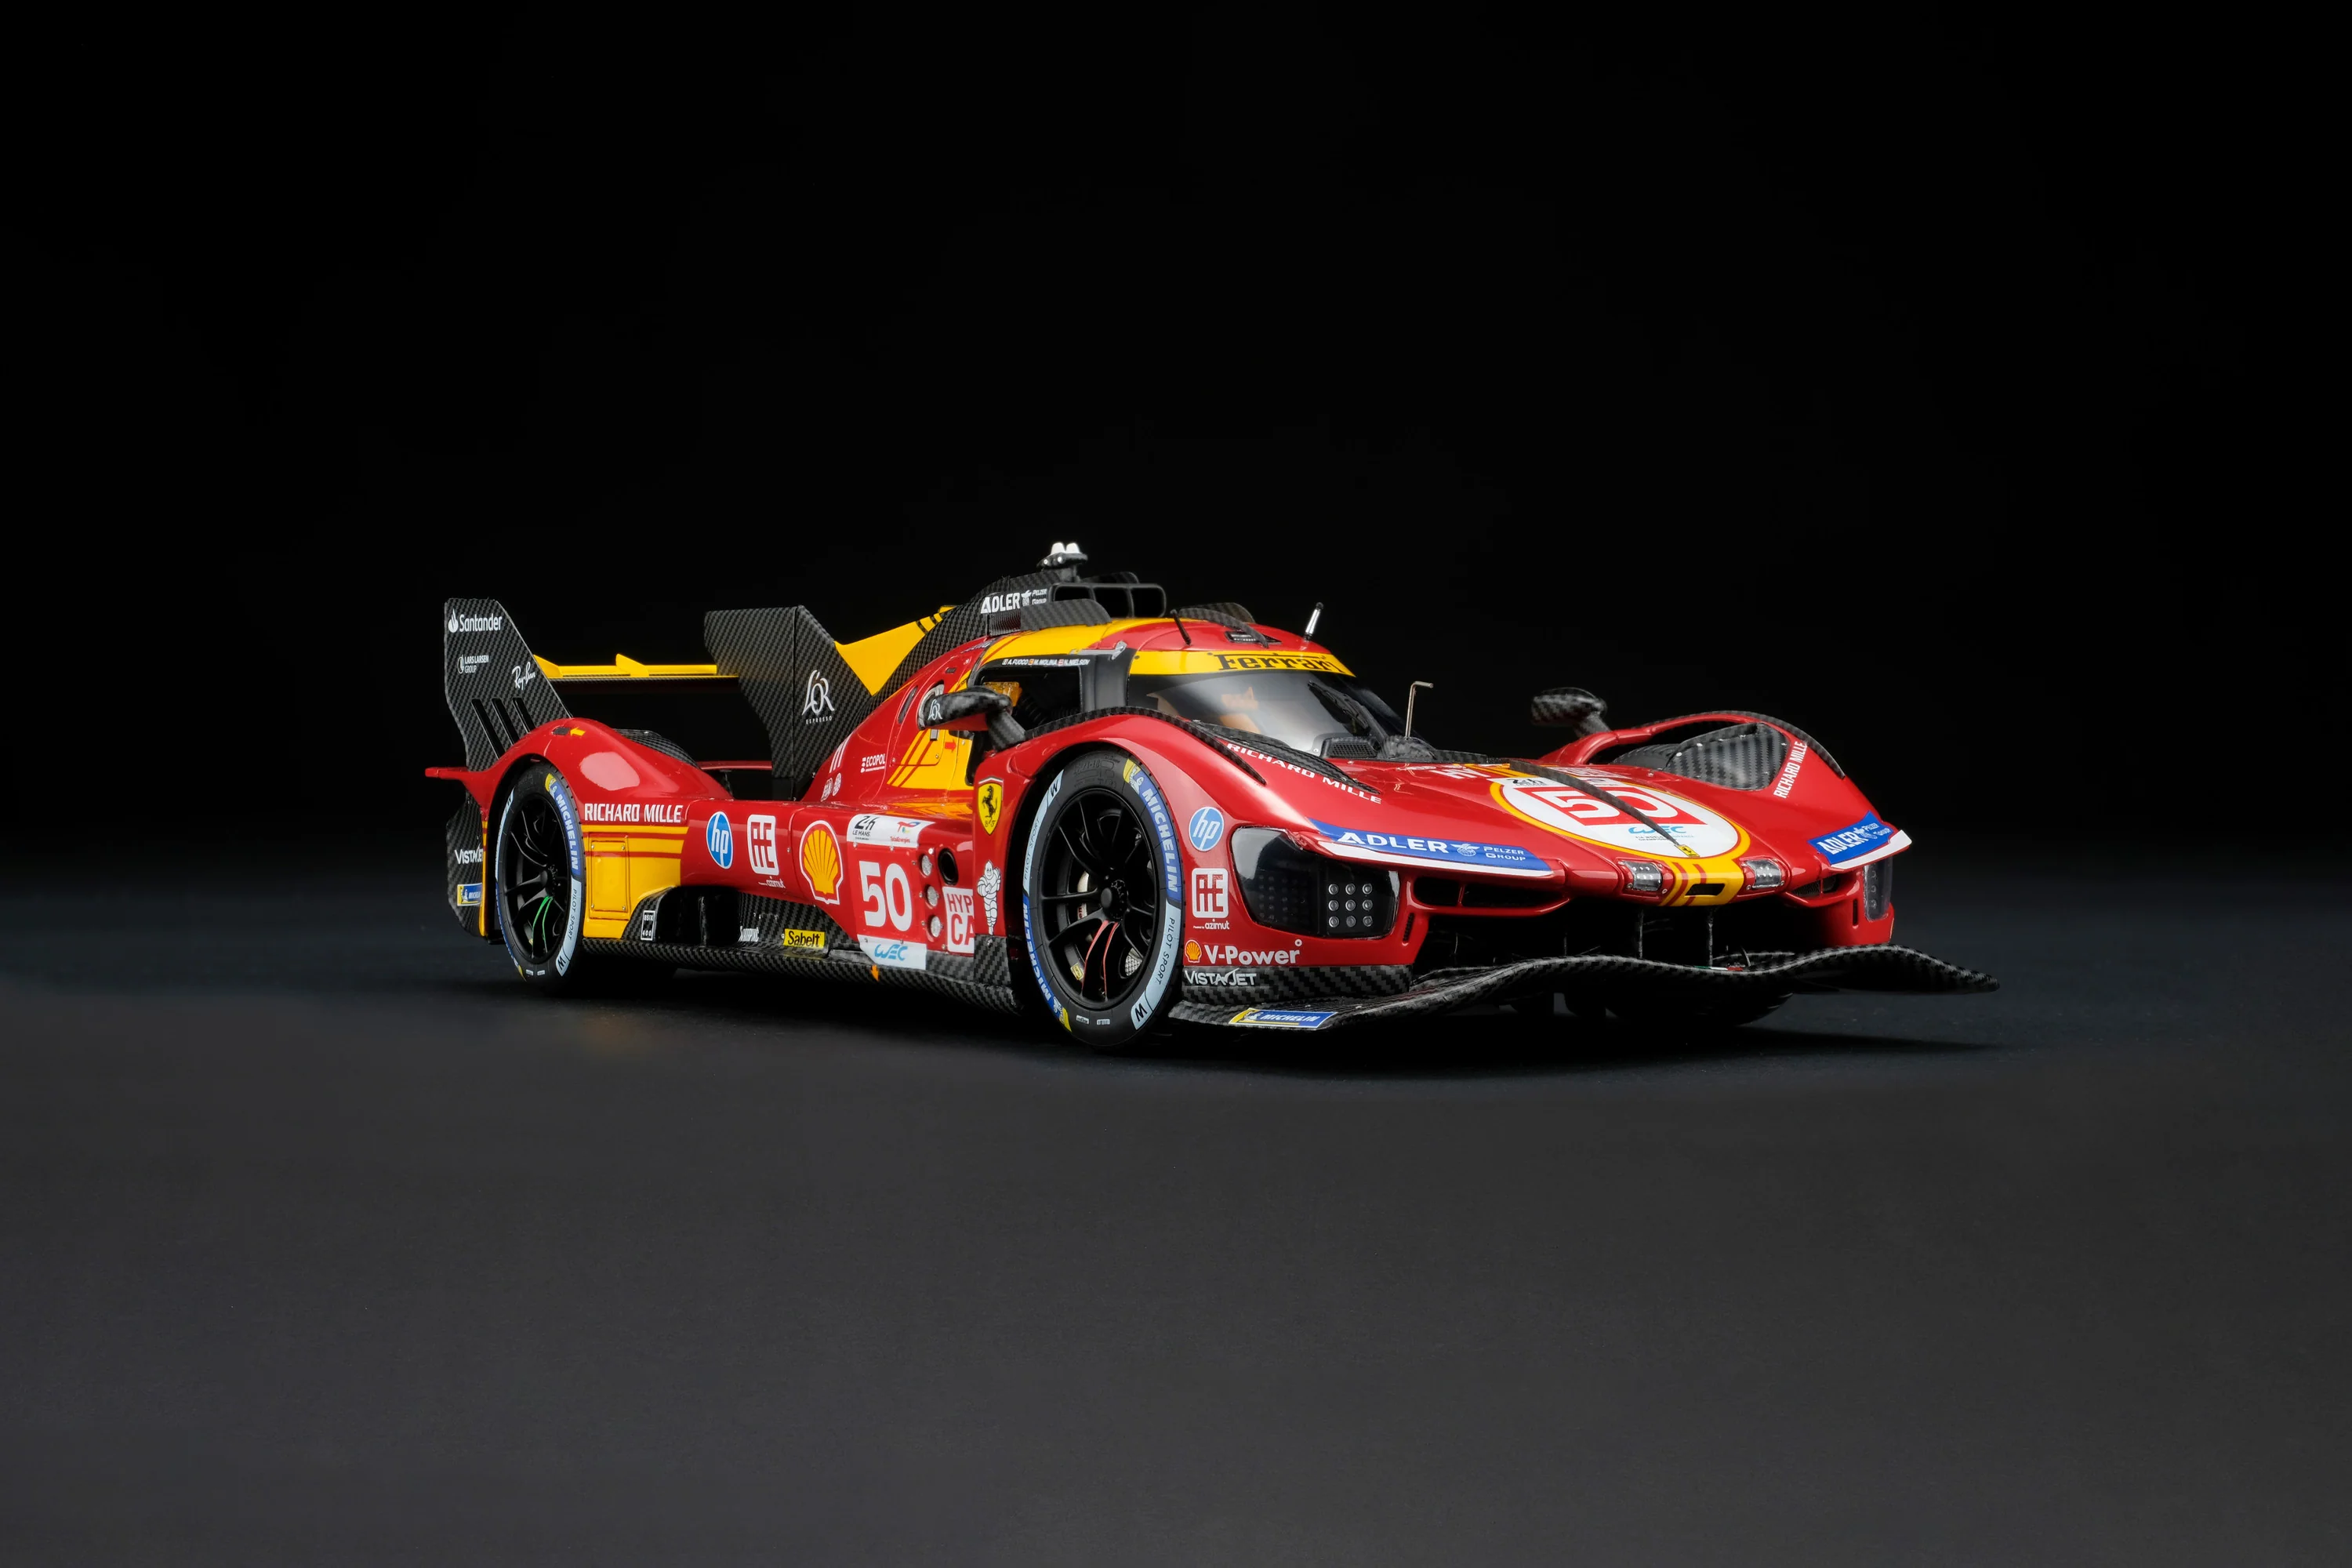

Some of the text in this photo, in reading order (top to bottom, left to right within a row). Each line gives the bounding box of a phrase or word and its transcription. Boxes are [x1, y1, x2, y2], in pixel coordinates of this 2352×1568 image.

[981, 593, 1020, 613] ADLER
[459, 613, 503, 632] Santander
[464, 665, 477, 673] GROUP
[474, 655, 488, 664] LARSEN
[1214, 654, 1345, 673] Ferrari
[806, 715, 833, 724] ESPRESSO
[866, 753, 886, 767] ECOPOL
[1773, 741, 1808, 798] RICHARD MILLE
[1227, 743, 1381, 804] RICHARD MILLE
[585, 804, 683, 822] RICHARD MILLE
[556, 794, 579, 871] MICHELIN
[1192, 808, 1221, 851] hp
[709, 812, 731, 869] hp
[1142, 789, 1178, 892] MICHELIN
[1338, 832, 1449, 854] ADLER
[1483, 846, 1524, 855] PELZER
[1817, 832, 1869, 855] ADLER
[859, 861, 913, 931] 50
[1205, 919, 1229, 930] azimut
[788, 931, 820, 946] Sabelt
[1023, 902, 1051, 1001] MICHELIN
[1157, 917, 1175, 985] PILOT SPORT
[1204, 945, 1300, 965] V-Power
[1135, 1003, 1148, 1022] W
